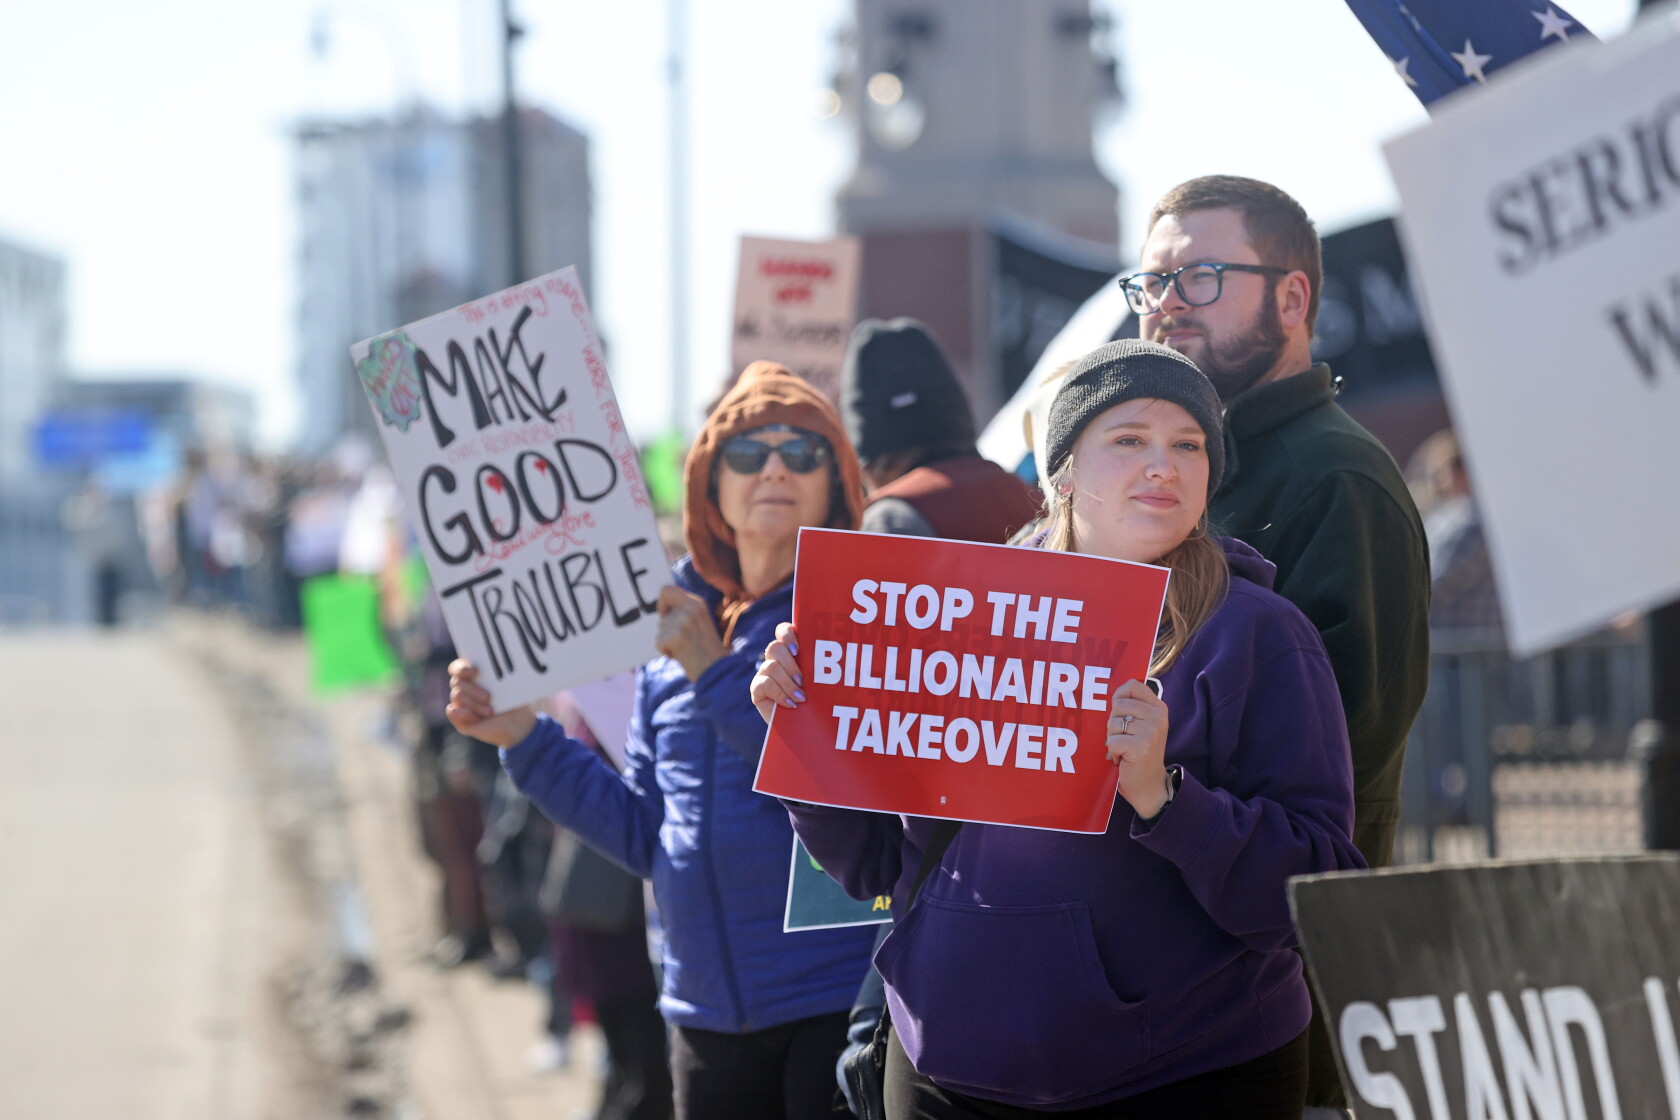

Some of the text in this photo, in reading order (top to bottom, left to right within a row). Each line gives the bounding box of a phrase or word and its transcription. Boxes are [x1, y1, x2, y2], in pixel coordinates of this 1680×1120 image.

[414, 305, 568, 449] MAKE
[418, 437, 618, 566] GOOD
[598, 399, 623, 445] FOR
[613, 445, 652, 511] JUSTICE
[441, 538, 658, 680] TROUBLE
[849, 578, 1085, 645] STOP THE
[813, 639, 1112, 712] BILLIONAIRE
[832, 705, 1079, 774] TAKEOVER
[1339, 985, 1623, 1120] STAND
